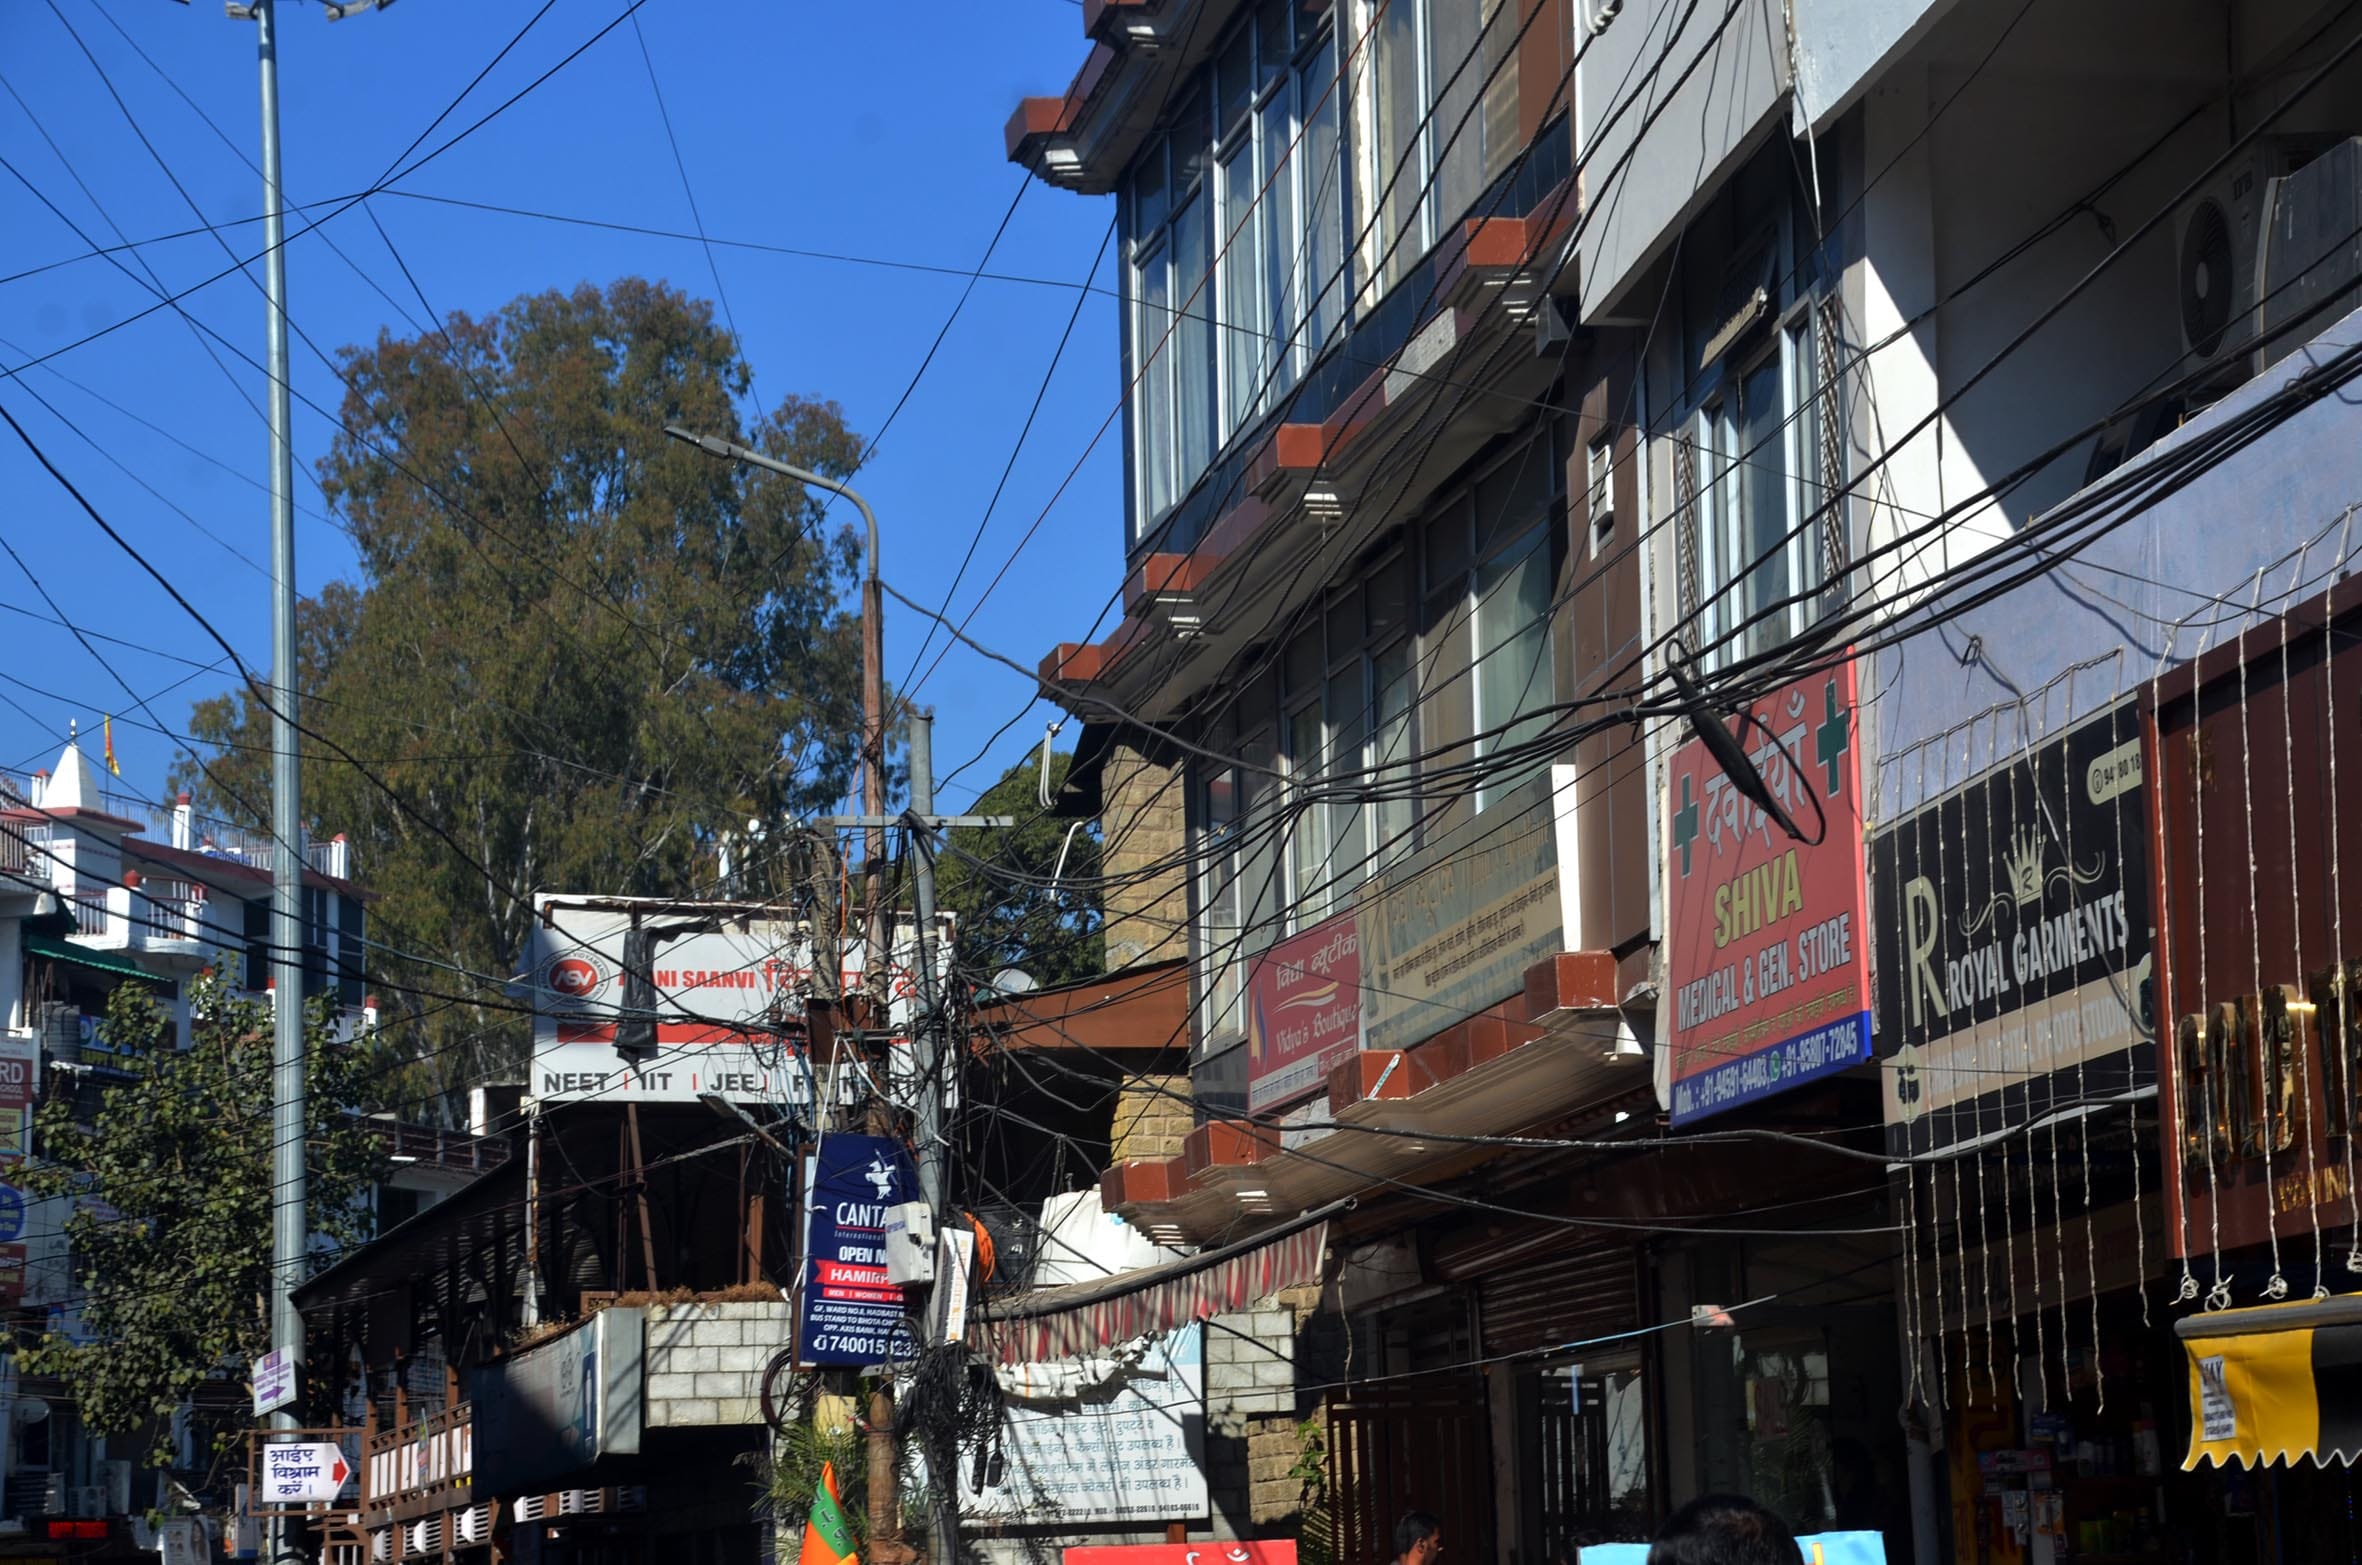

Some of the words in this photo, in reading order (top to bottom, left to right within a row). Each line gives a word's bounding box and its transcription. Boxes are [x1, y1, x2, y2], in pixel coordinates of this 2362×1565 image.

[1714, 847, 1803, 948] SHIVA
[1905, 875, 1949, 1028] R
[1948, 941, 2010, 1012] ROYAL
[2013, 889, 2129, 987] GARMENTS
[682, 970, 755, 989] SAANVI
[1678, 963, 1739, 1033] MEDICAL
[1744, 956, 1755, 1006] &
[1759, 938, 1794, 999] GEN.
[1798, 911, 1852, 982] STORE
[1312, 1002, 1358, 1040] Boutique
[544, 1072, 608, 1092] NEET
[710, 1072, 755, 1092] JEE
[838, 1245, 873, 1264] OPEN
[271, 1465, 321, 1480] विश्राम
[277, 1480, 303, 1496] करें
